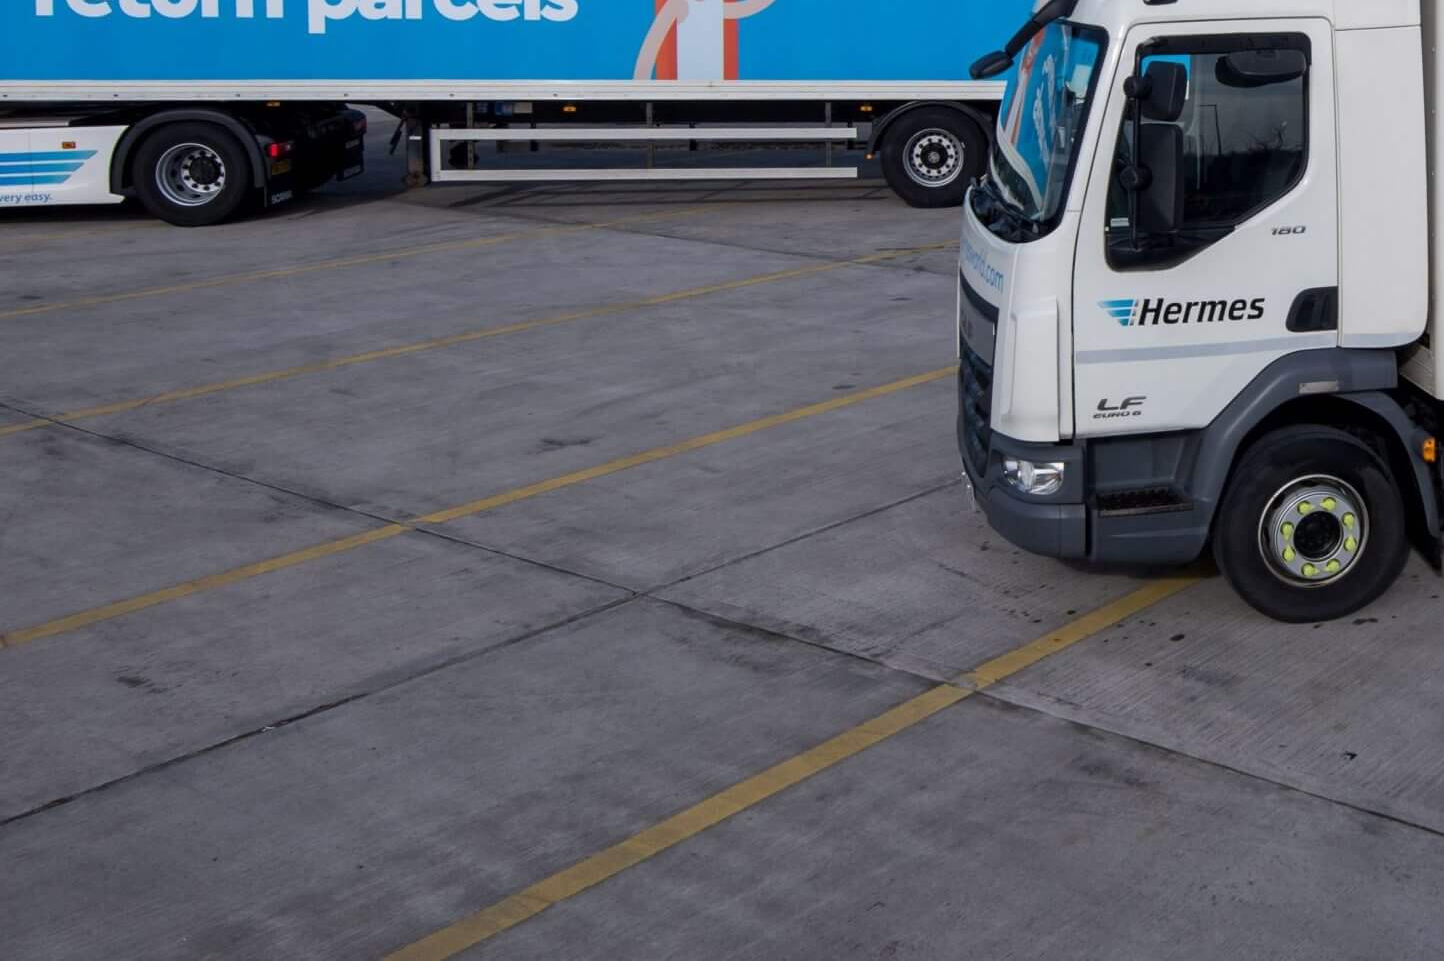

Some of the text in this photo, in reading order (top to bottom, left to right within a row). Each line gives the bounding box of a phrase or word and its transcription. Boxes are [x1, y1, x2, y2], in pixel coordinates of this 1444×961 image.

[1271, 225, 1306, 236] 180
[1138, 298, 1265, 326] Hermes
[1097, 396, 1146, 411] LF
